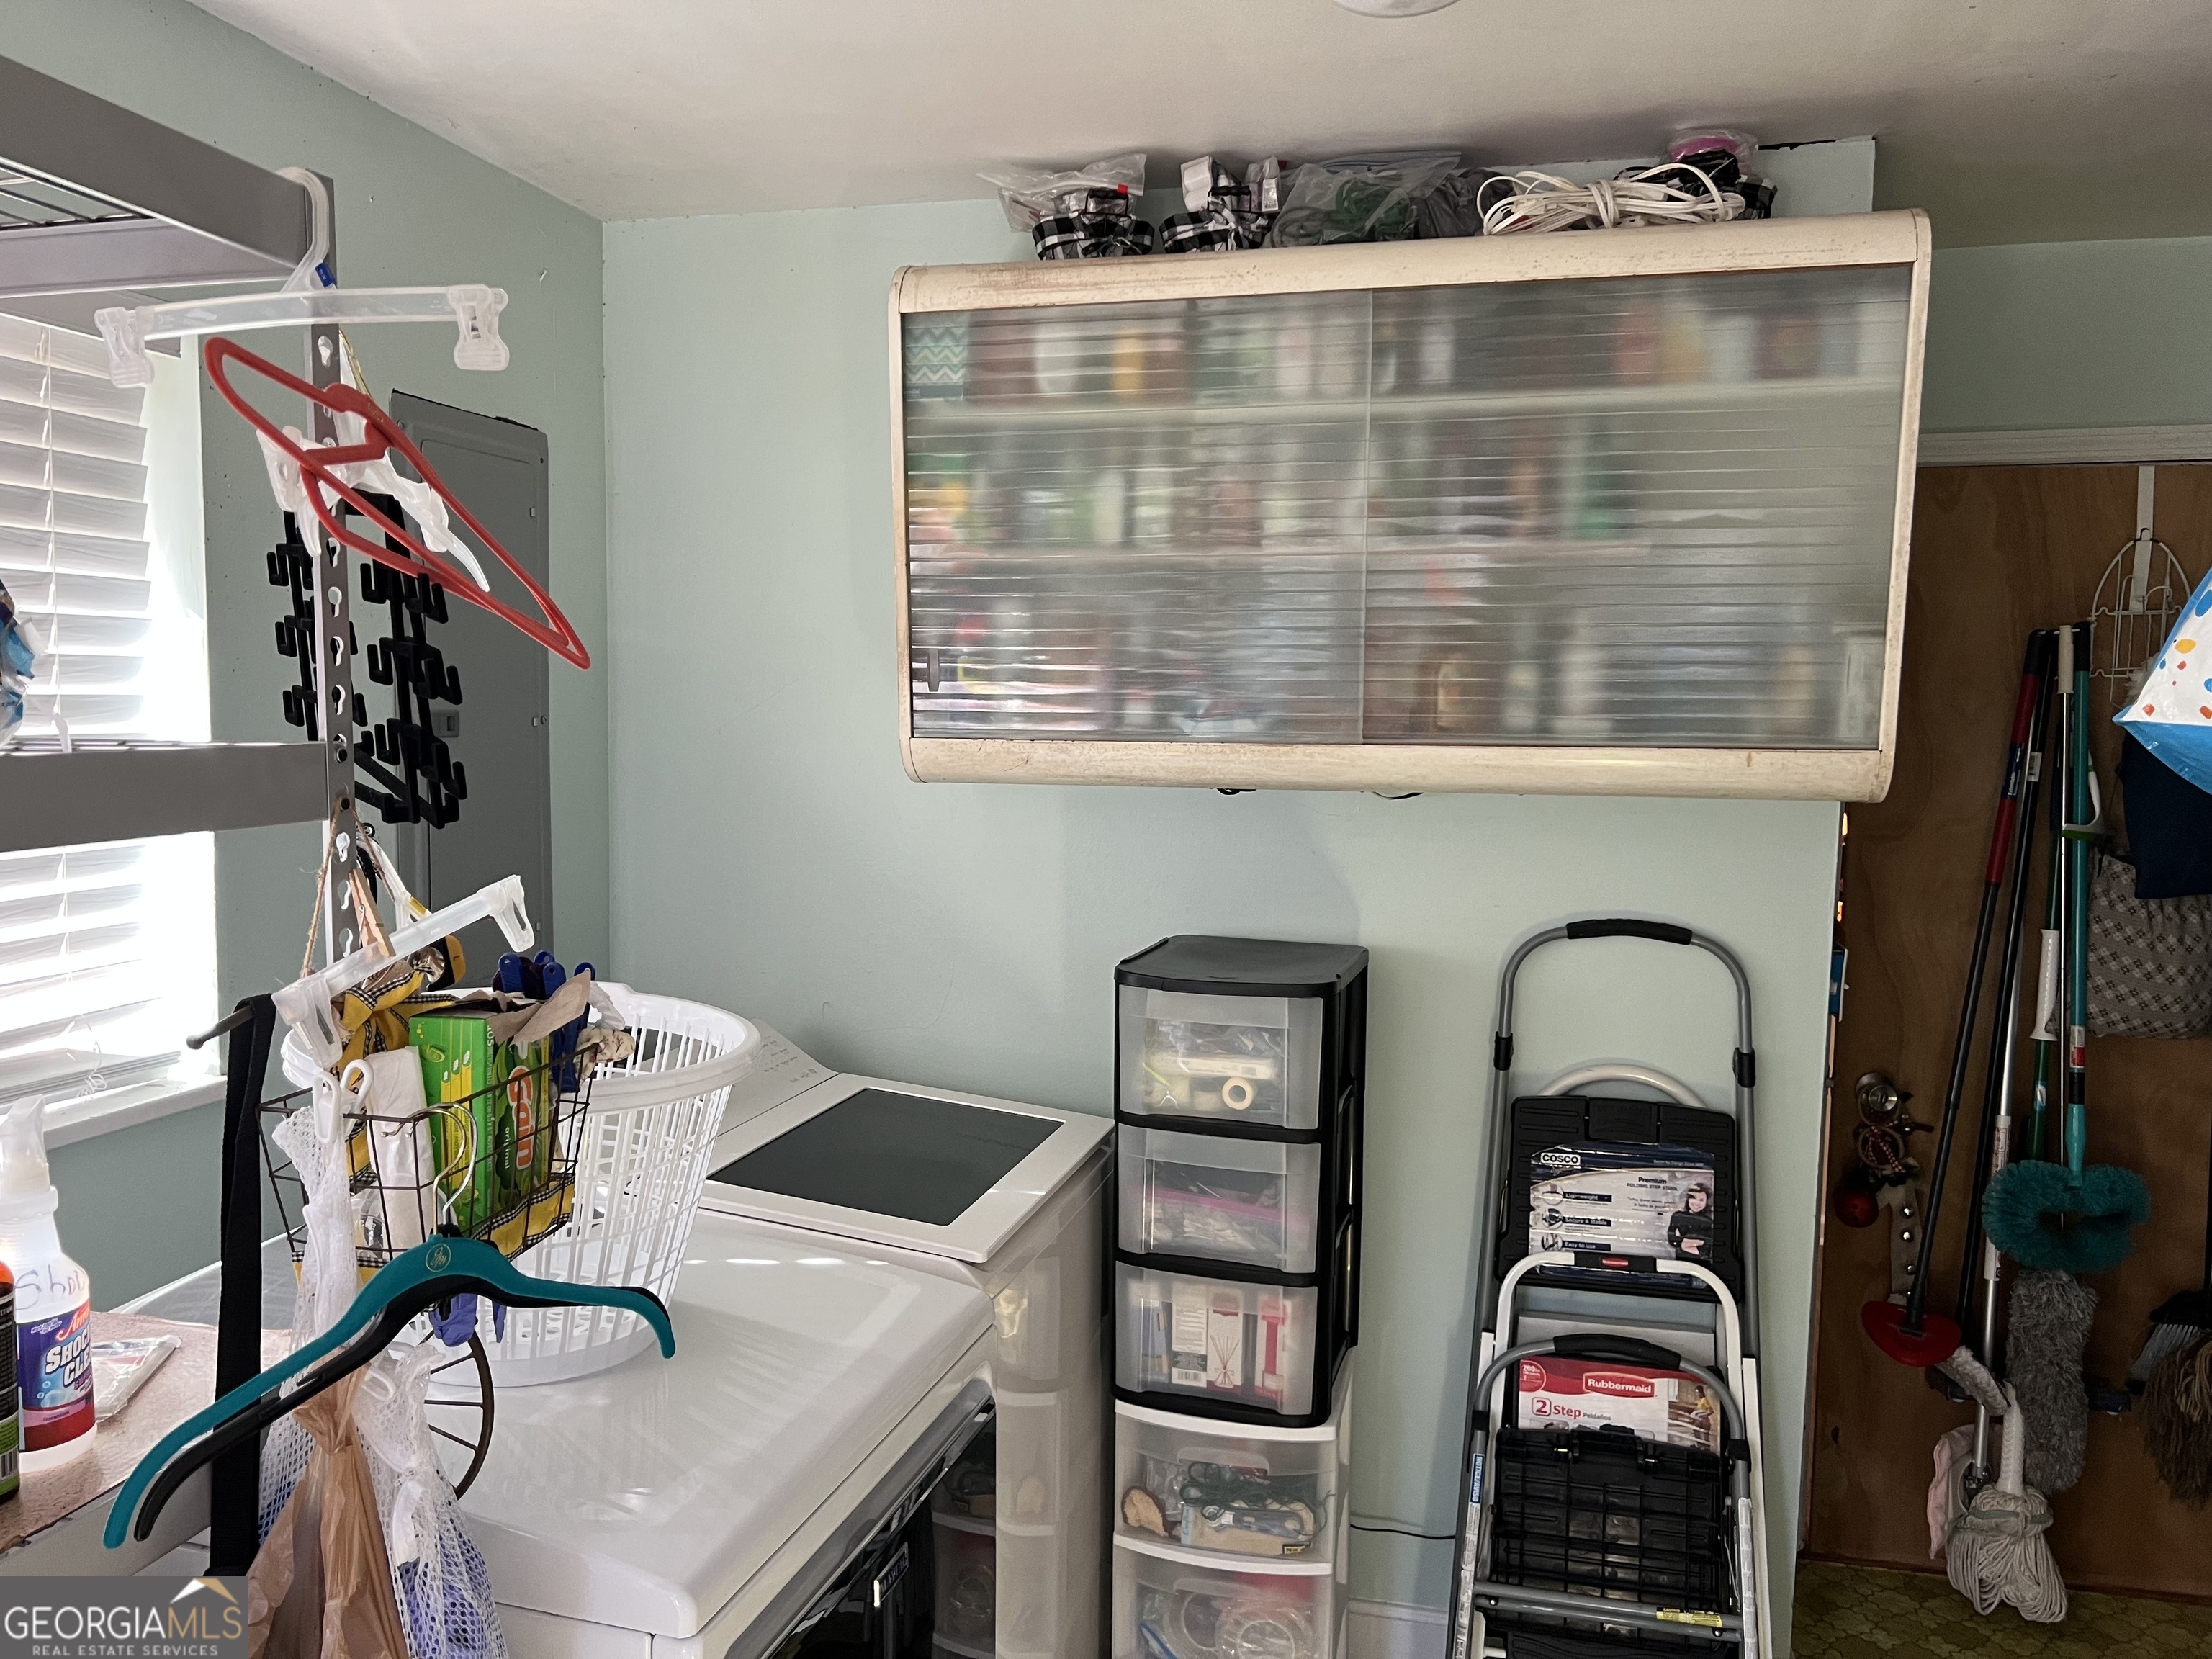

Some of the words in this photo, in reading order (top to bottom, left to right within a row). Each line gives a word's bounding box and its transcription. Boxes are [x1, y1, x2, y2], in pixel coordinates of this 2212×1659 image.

[507, 1066, 533, 1170] Gain
[1542, 1154, 1579, 1164] COSCO
[1588, 1378, 1652, 1394] Rubbermaid
[1535, 1399, 1547, 1413] 2
[1553, 1405, 1581, 1419] Step
